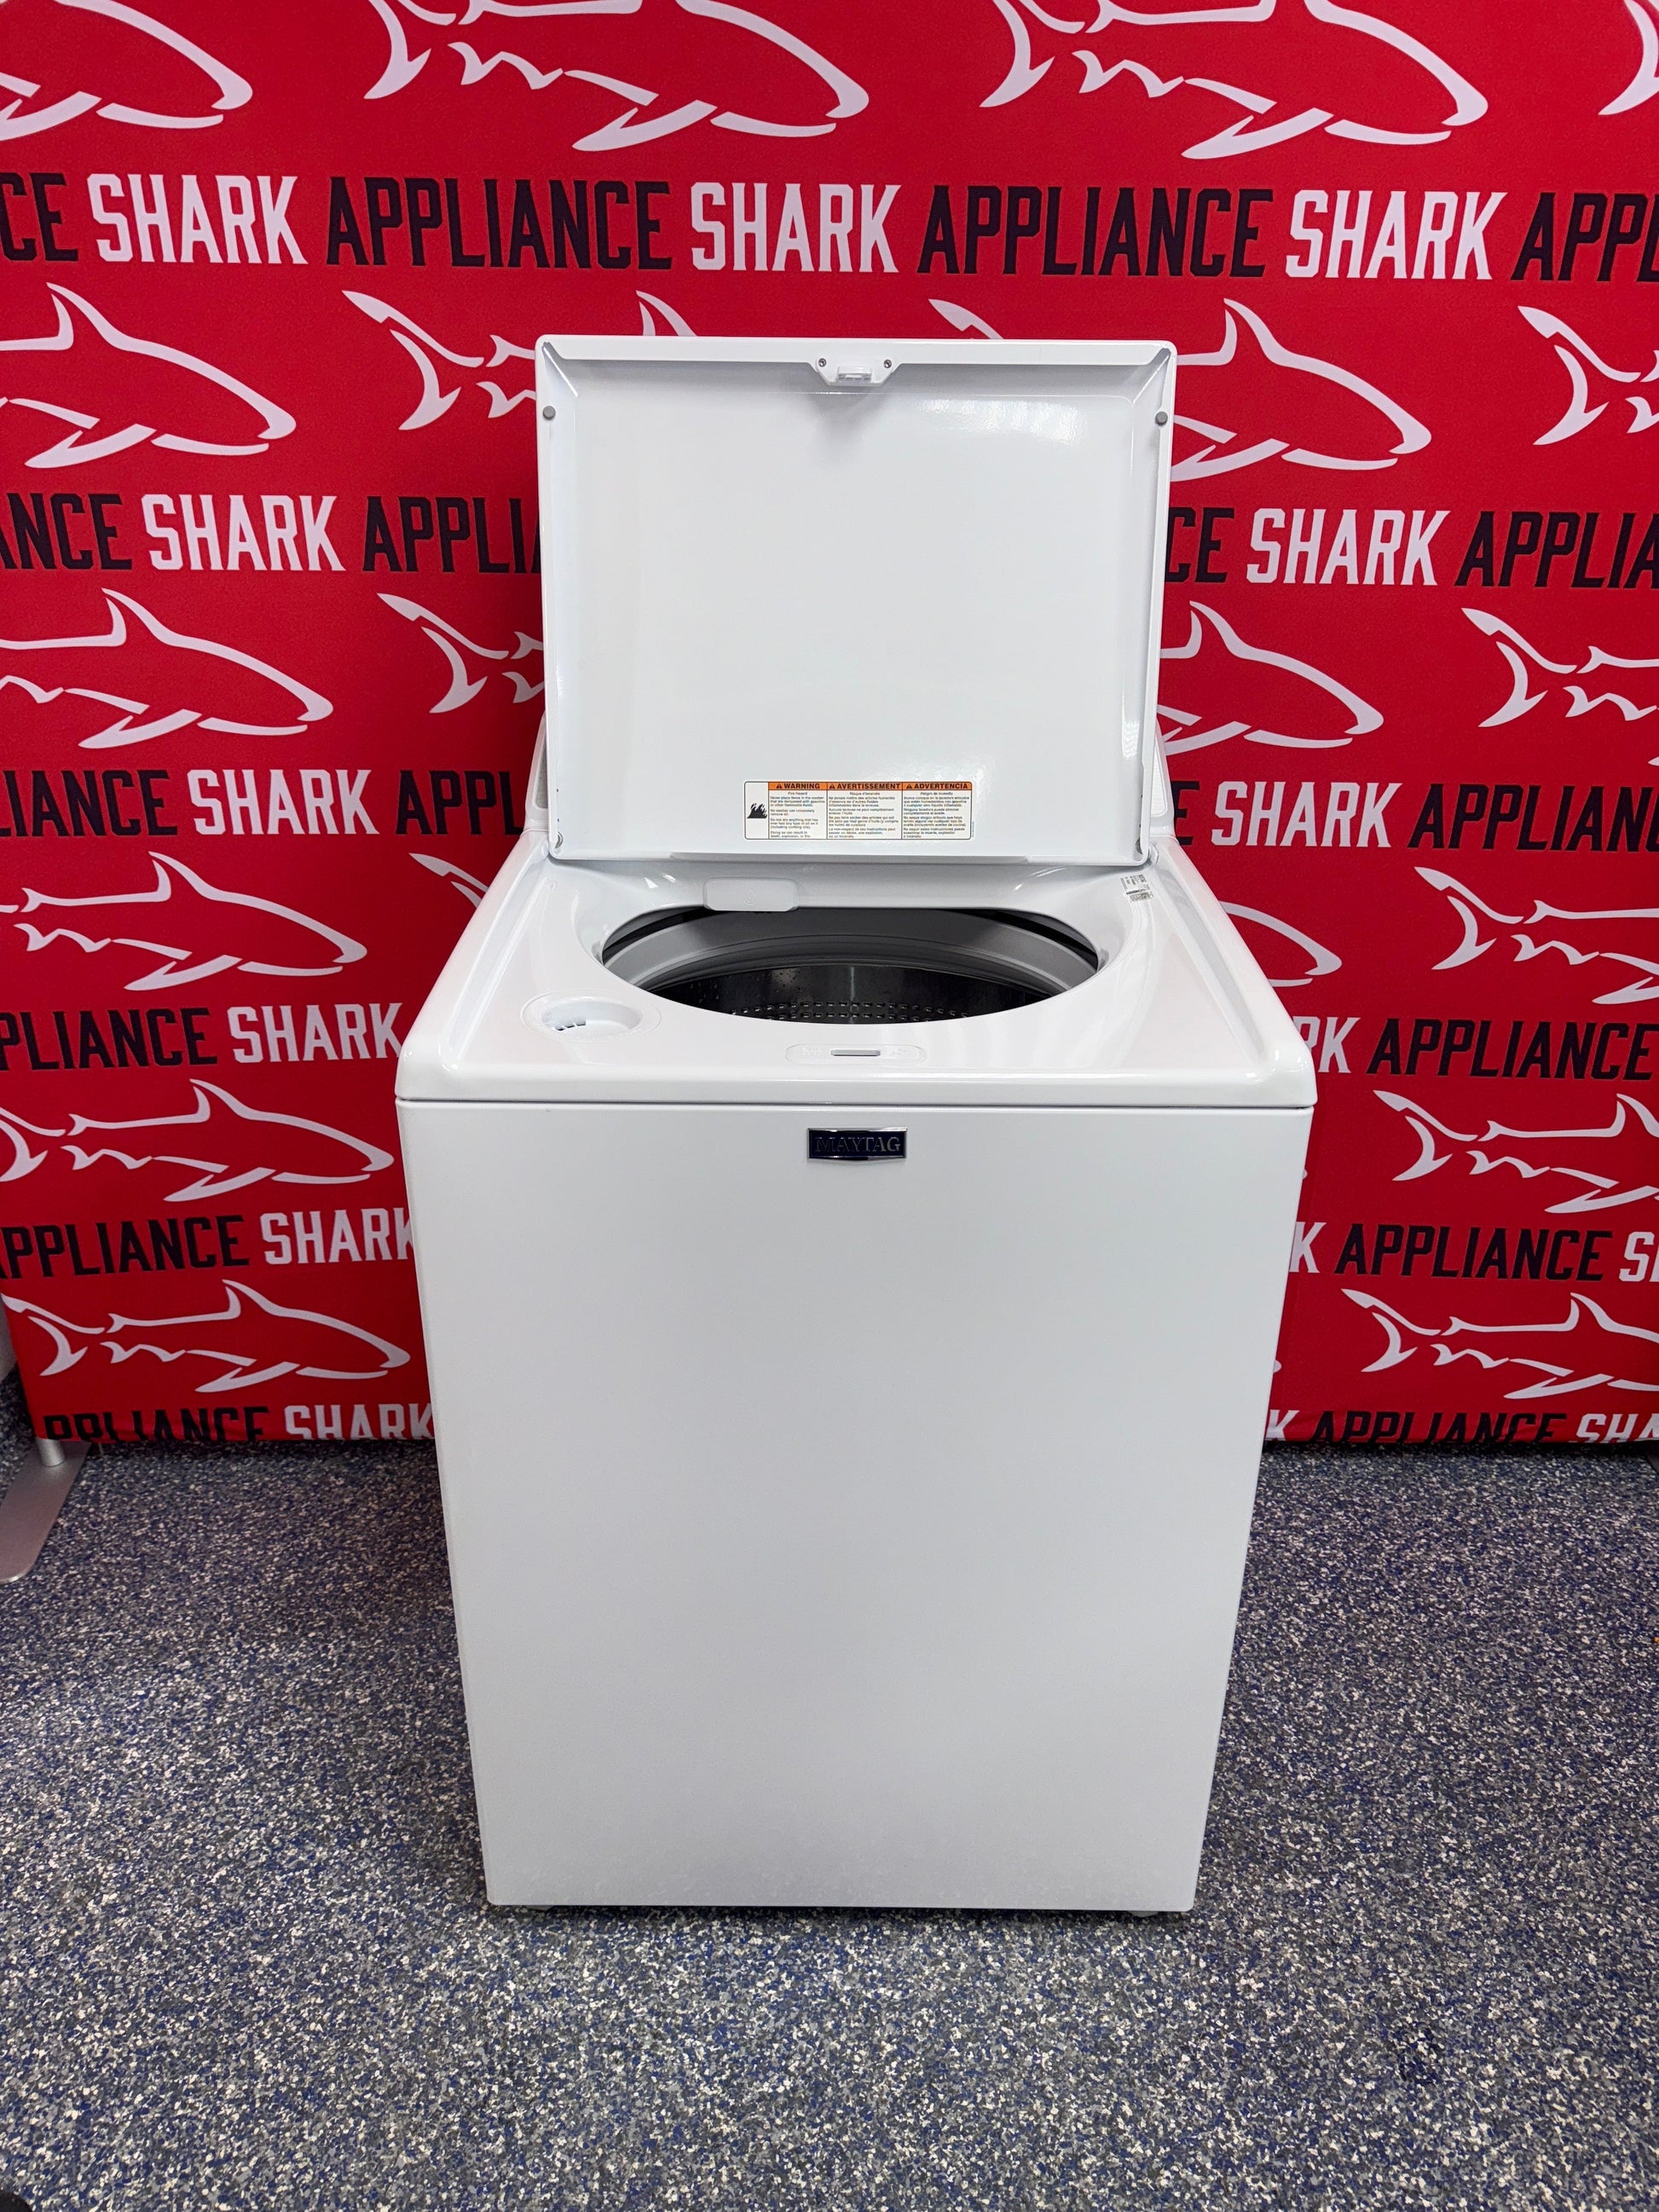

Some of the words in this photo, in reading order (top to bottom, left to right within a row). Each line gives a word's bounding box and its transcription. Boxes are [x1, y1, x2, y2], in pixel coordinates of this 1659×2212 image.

[89, 173, 308, 264] SHARK
[327, 176, 672, 270] APPLIANCE
[691, 182, 901, 274] SHARK
[917, 185, 1273, 278] APPLIANCE
[1285, 190, 1507, 280] SHARK
[142, 494, 346, 571] SHARK
[362, 496, 540, 573] APPLI
[1246, 508, 1451, 586] SHARK
[1454, 511, 1659, 589] APPLIA
[187, 769, 380, 835] SHARK
[1211, 781, 1402, 847] SHARK
[1407, 783, 1659, 852] APPLIAN
[0, 1008, 217, 1071] PLIANCE
[228, 1002, 403, 1063] SHARK
[1366, 1018, 1659, 1080] APPLIANCE
[815, 1136, 901, 1152] MAYTAG
[0, 1215, 249, 1279] PPLIANCE
[1334, 1223, 1612, 1282] APPLIANCE
